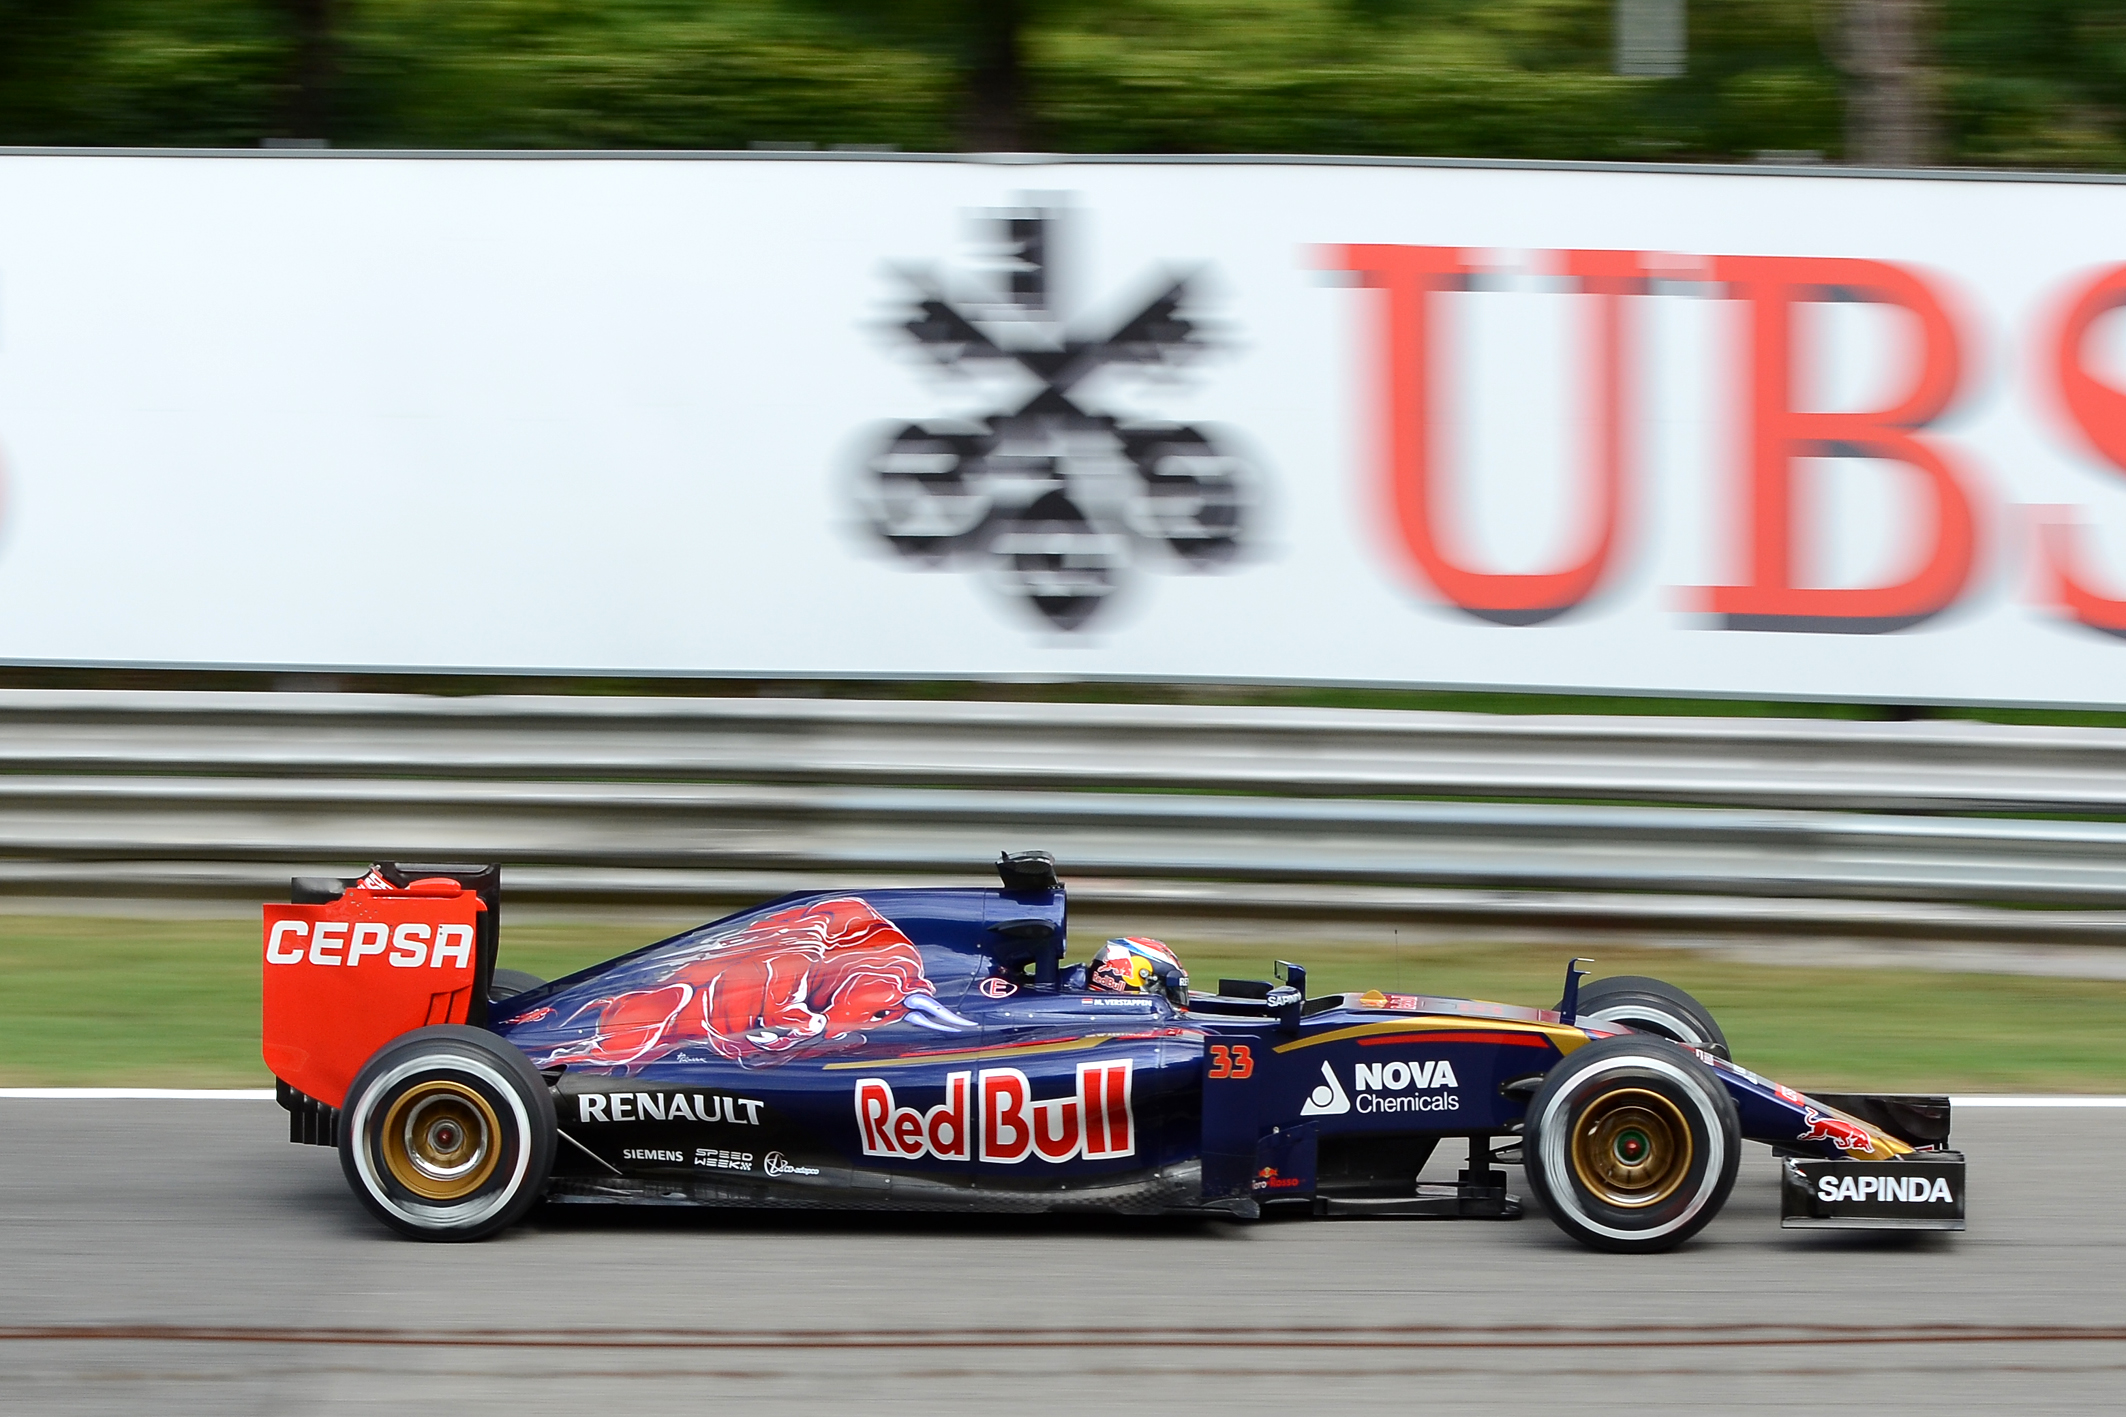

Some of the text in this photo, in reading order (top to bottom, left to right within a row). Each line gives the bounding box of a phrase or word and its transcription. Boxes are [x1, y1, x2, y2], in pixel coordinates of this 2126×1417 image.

[265, 919, 475, 969] CEPSA
[1208, 1045, 1254, 1079] 33
[1355, 1060, 1459, 1091] NOVA
[577, 1093, 765, 1125] RENAULT
[854, 1058, 1134, 1164] Red Bull
[1355, 1092, 1460, 1114] Chemicals
[623, 1148, 684, 1162] SIEMENS
[694, 1157, 741, 1170] WEEK
[695, 1147, 754, 1162] SPEED
[1818, 1176, 1953, 1203] SAPINDA
